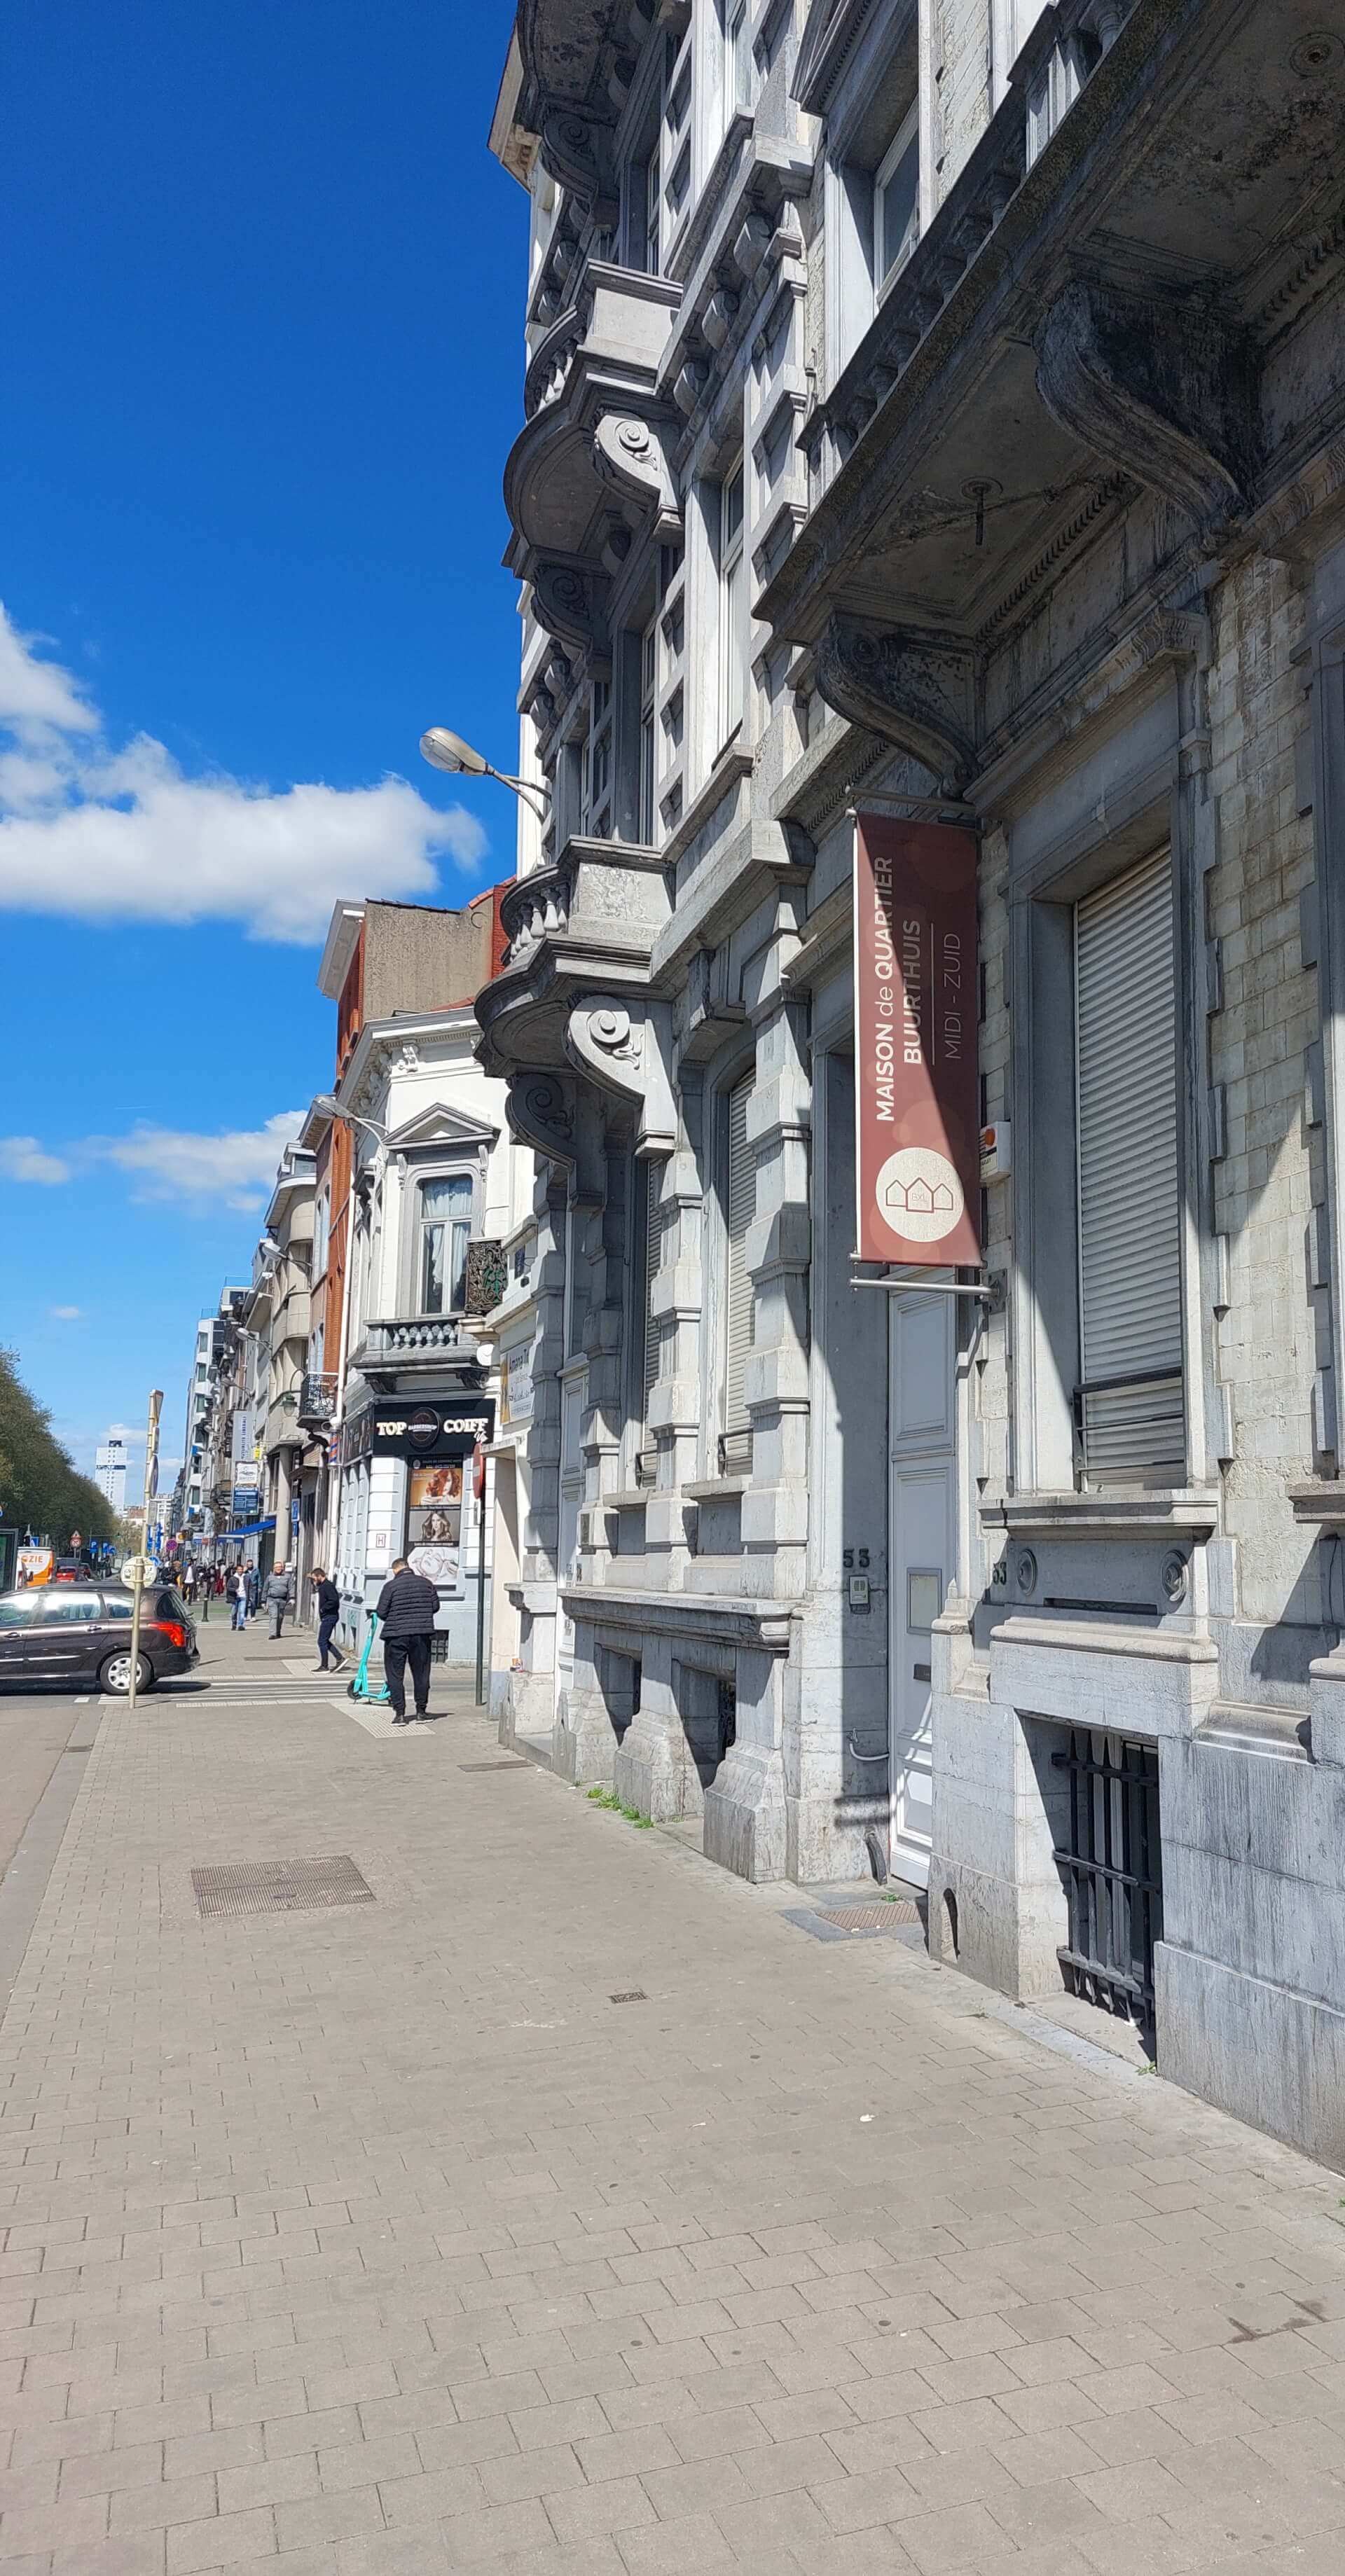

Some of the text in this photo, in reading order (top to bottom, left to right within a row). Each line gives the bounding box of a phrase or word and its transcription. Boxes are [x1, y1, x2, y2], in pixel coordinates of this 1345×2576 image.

[943, 932, 962, 989] ZUID
[874, 856, 895, 1122] MAISON de QUARTIER
[902, 919, 923, 1065] BUURTHUIS
[944, 1011, 963, 1060] MIDI
[376, 1418, 488, 1436] TOP COIFF
[843, 1548, 870, 1568] 53
